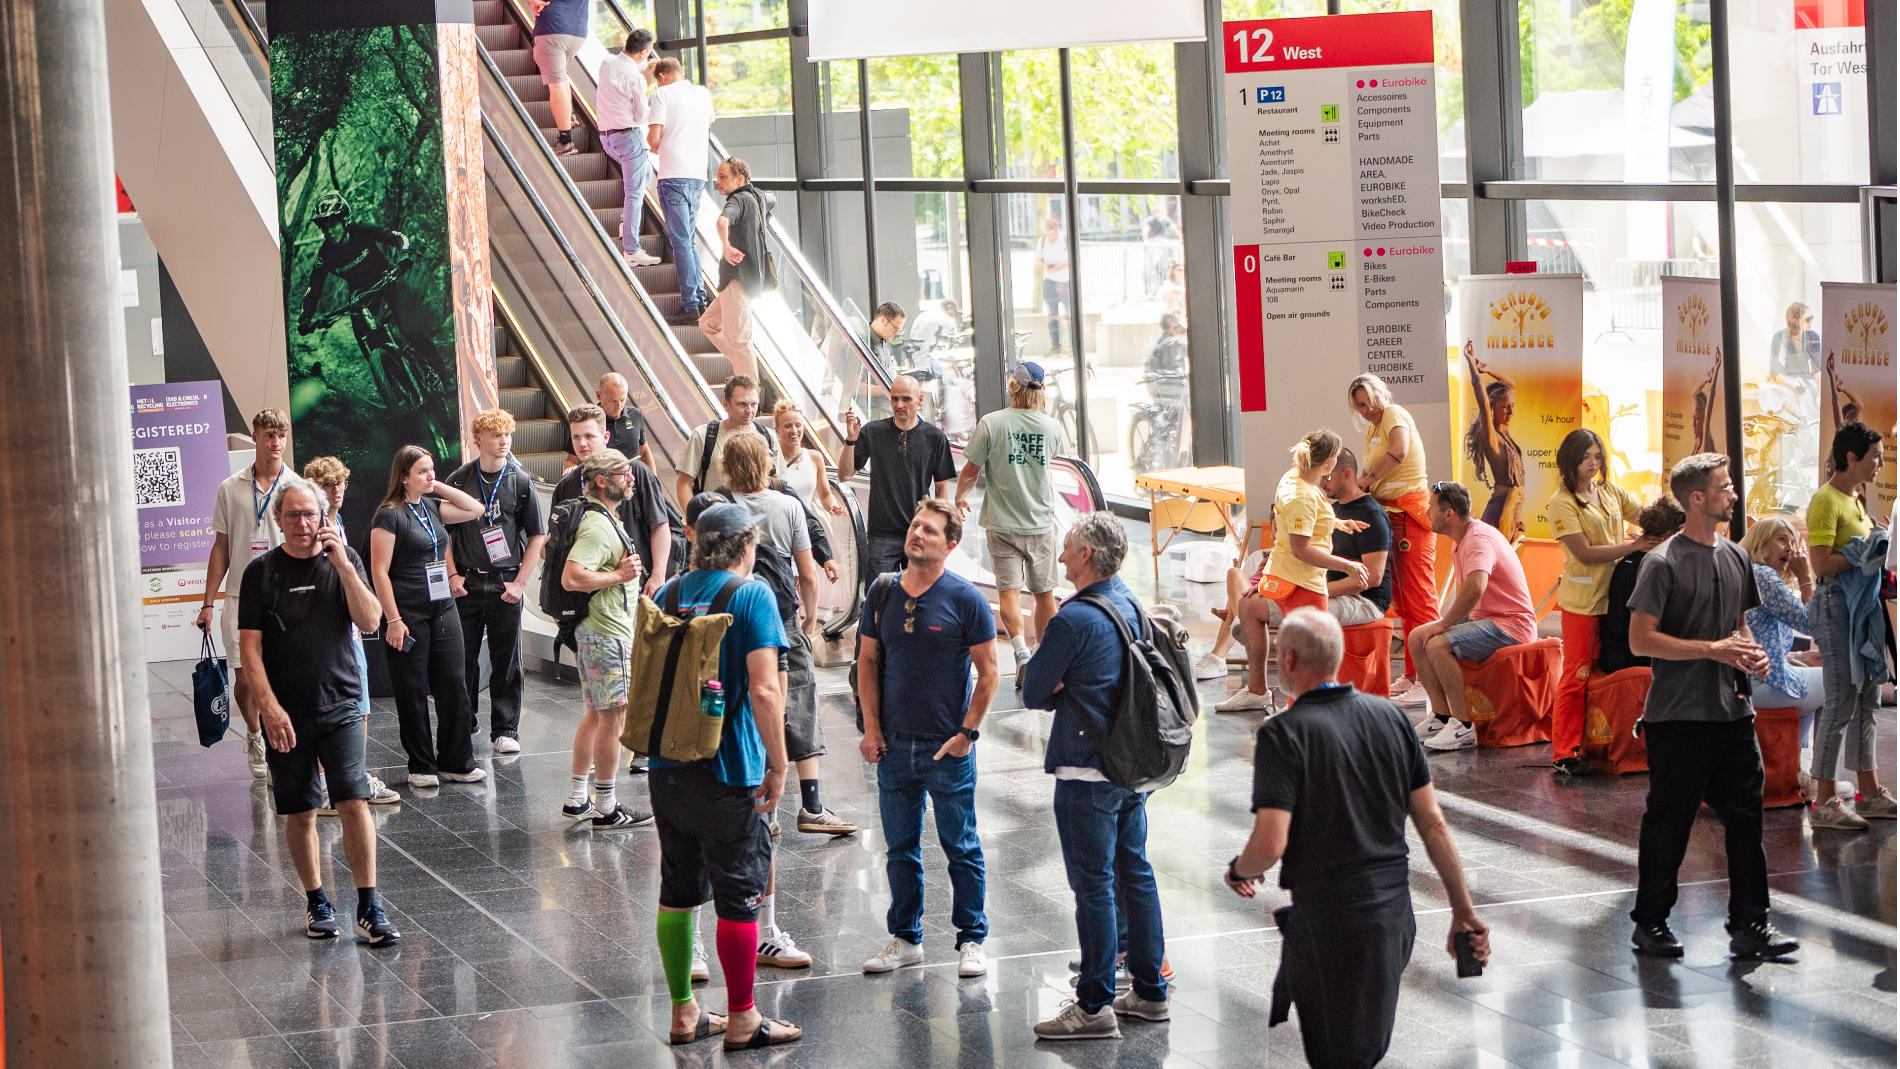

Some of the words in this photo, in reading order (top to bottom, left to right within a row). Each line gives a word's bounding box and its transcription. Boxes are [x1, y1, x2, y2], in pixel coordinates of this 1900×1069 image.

[1233, 28, 1275, 63] 12
[1283, 46, 1323, 61] West
[1810, 41, 1866, 55] Ausfahr
[1810, 62, 1832, 76] Tor
[1837, 61, 1867, 75] Wes
[1382, 77, 1427, 88] Eurobike
[1239, 88, 1247, 106] 1
[1260, 90, 1269, 100] P
[1271, 90, 1283, 100] 12
[1357, 92, 1407, 102] Accessoires
[1257, 107, 1298, 115] Restaurant
[1357, 105, 1411, 116] Components
[1358, 119, 1404, 129] Equipment
[1259, 129, 1290, 138] Meeting
[1359, 132, 1380, 141] Parts
[1259, 139, 1280, 147] Achat
[1260, 148, 1294, 157] Amethyst
[1260, 158, 1294, 166] Aventurin
[1359, 155, 1414, 167] HANDMADE
[1282, 167, 1304, 175] Jaspis
[1360, 170, 1387, 179] AREA,
[1261, 178, 1280, 186] Lapis
[1360, 181, 1406, 192] EUROBIKE
[1284, 187, 1300, 195] Opal
[1361, 194, 1407, 205] workshED,
[1262, 207, 1283, 215] Rubin
[1361, 208, 1406, 218] BikeCheck
[1262, 217, 1285, 226] Saphir
[1362, 221, 1386, 231] Video
[1388, 219, 1435, 230] Production
[1263, 226, 1295, 235] Smaragd
[1389, 245, 1435, 256] Eurobike
[1264, 253, 1281, 262] Café
[1244, 255, 1256, 273] 0
[1364, 262, 1387, 271] Bikes
[1265, 276, 1297, 285] Meeting
[1298, 275, 1322, 283] rooms
[1364, 274, 1396, 283] E-Bikes
[1265, 285, 1305, 295] Aquamarin
[1364, 288, 1387, 297] Parts
[1365, 299, 1420, 310] Components
[1266, 312, 1286, 321] Open
[1288, 311, 1297, 319] air
[1299, 310, 1331, 320] grounds
[1366, 323, 1412, 334] EUROBIKE
[1366, 337, 1403, 347] CAREER
[1487, 335, 1554, 349] MASSAGE
[1367, 350, 1405, 360] CENTER,
[1368, 362, 1414, 373] EUROBIKE
[1540, 414, 1554, 424] 1/4
[1555, 415, 1575, 424] hour
[130, 423, 210, 439] EGISTERED?
[1527, 448, 1552, 459] upper
[144, 521, 155, 529] as
[166, 517, 201, 527] Visitor
[144, 530, 176, 542] please
[179, 528, 203, 538] scan
[160, 543, 170, 551] to
[173, 540, 211, 551] register
